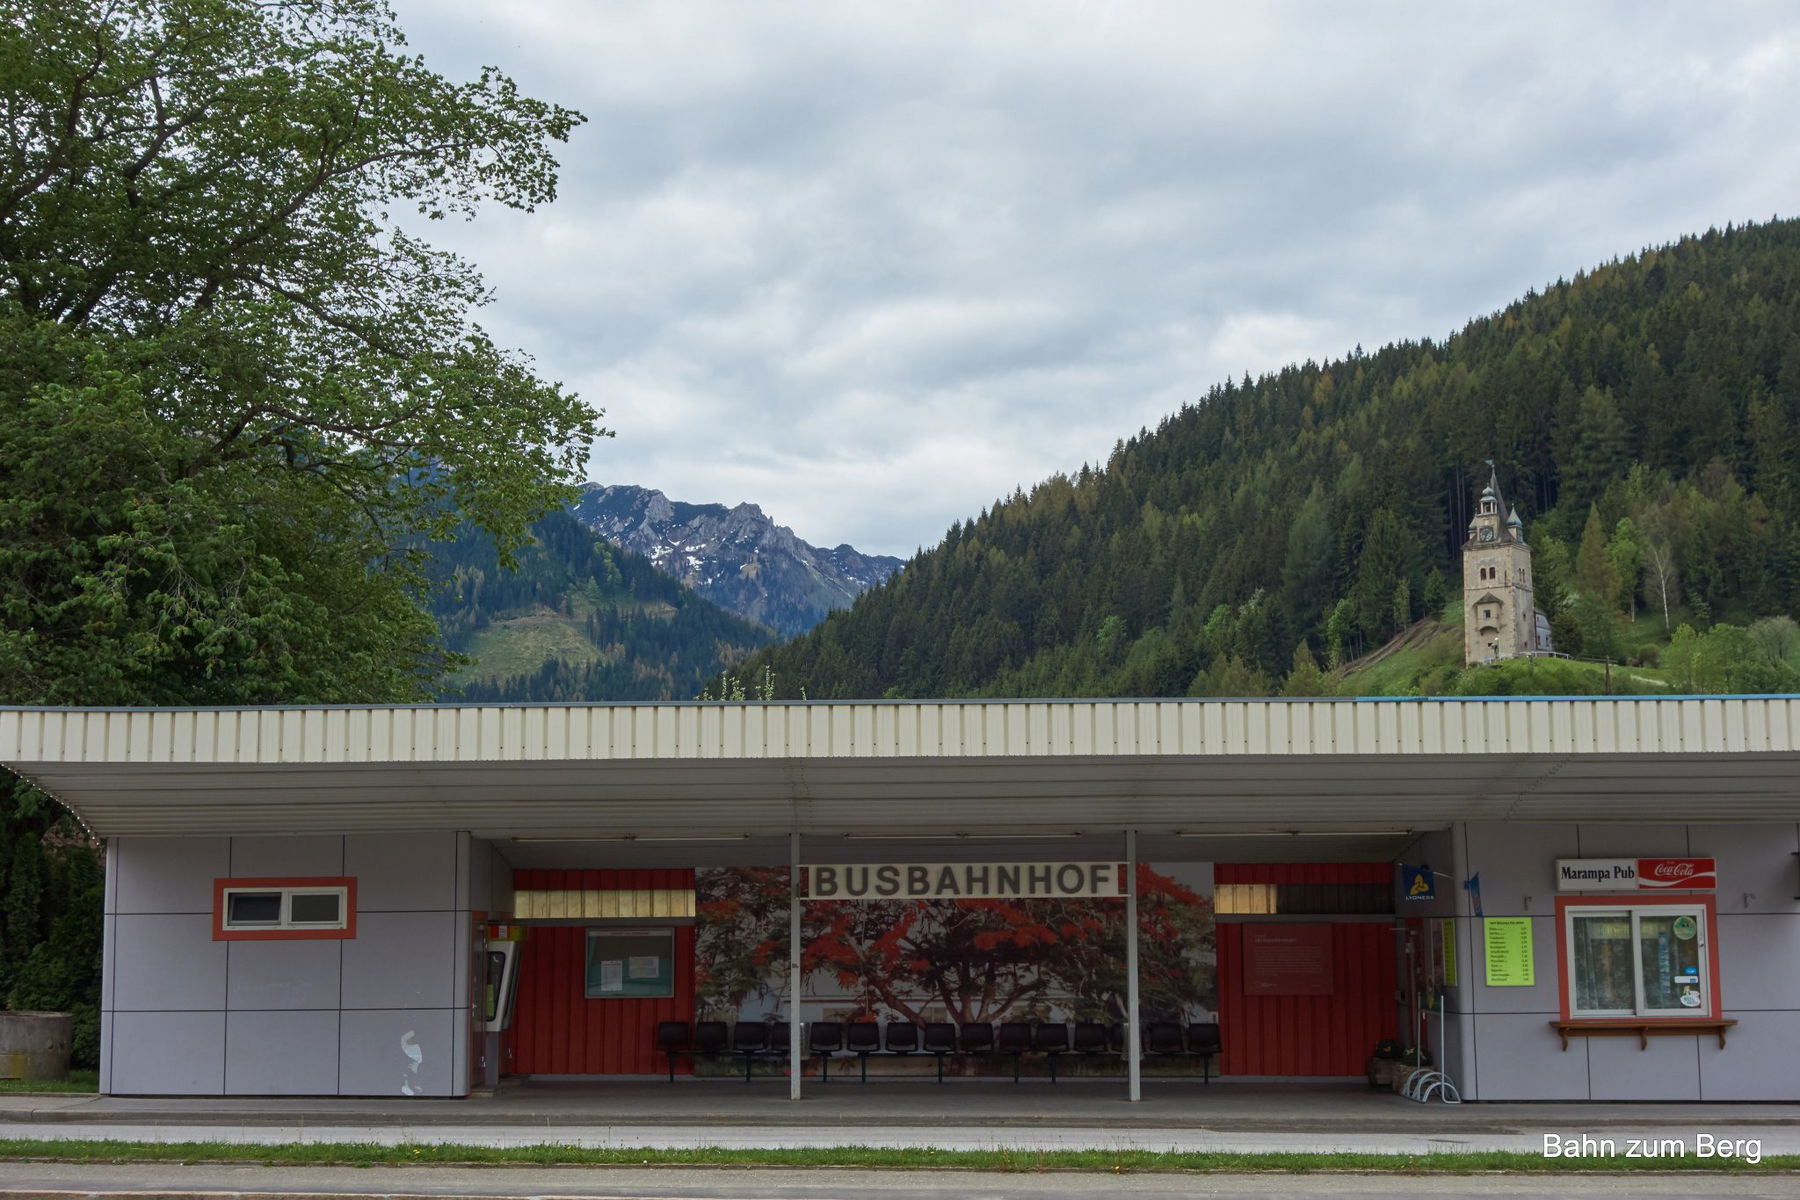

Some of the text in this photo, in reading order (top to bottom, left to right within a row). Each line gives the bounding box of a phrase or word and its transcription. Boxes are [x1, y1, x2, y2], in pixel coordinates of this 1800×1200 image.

[815, 864, 1111, 896] BUSBAHNHOF
[1561, 865, 1635, 882] Marampa Pub
